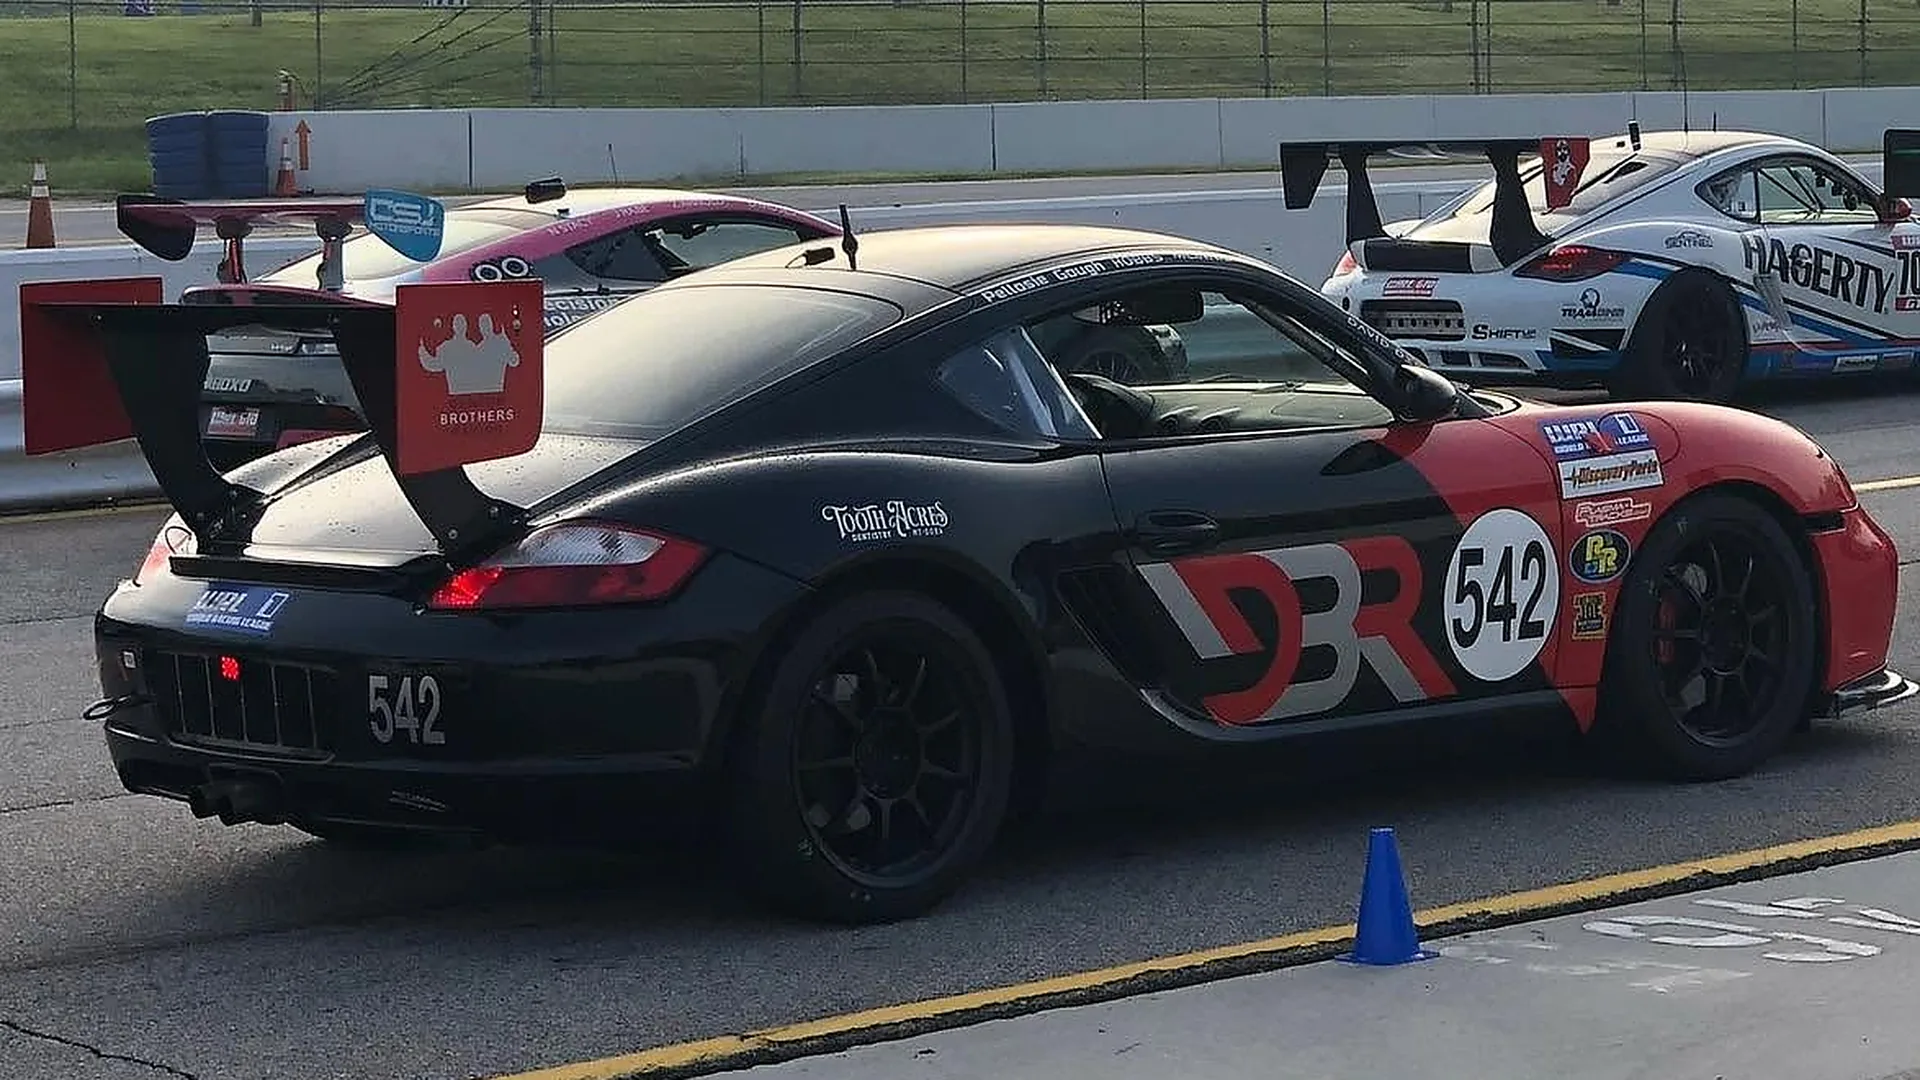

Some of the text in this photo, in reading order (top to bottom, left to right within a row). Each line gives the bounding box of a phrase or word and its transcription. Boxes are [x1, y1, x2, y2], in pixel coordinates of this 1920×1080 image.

[1052, 262, 1107, 281] Gough
[1740, 233, 1895, 314] HAGERTY
[1346, 316, 1390, 348] DAVID
[1471, 323, 1521, 340] SHIFT
[439, 408, 516, 426] BROTHERS
[821, 500, 949, 540] TOOTH ACRES
[1451, 539, 1546, 649] 542
[1135, 534, 1459, 727] DBR
[368, 674, 447, 745] 542
